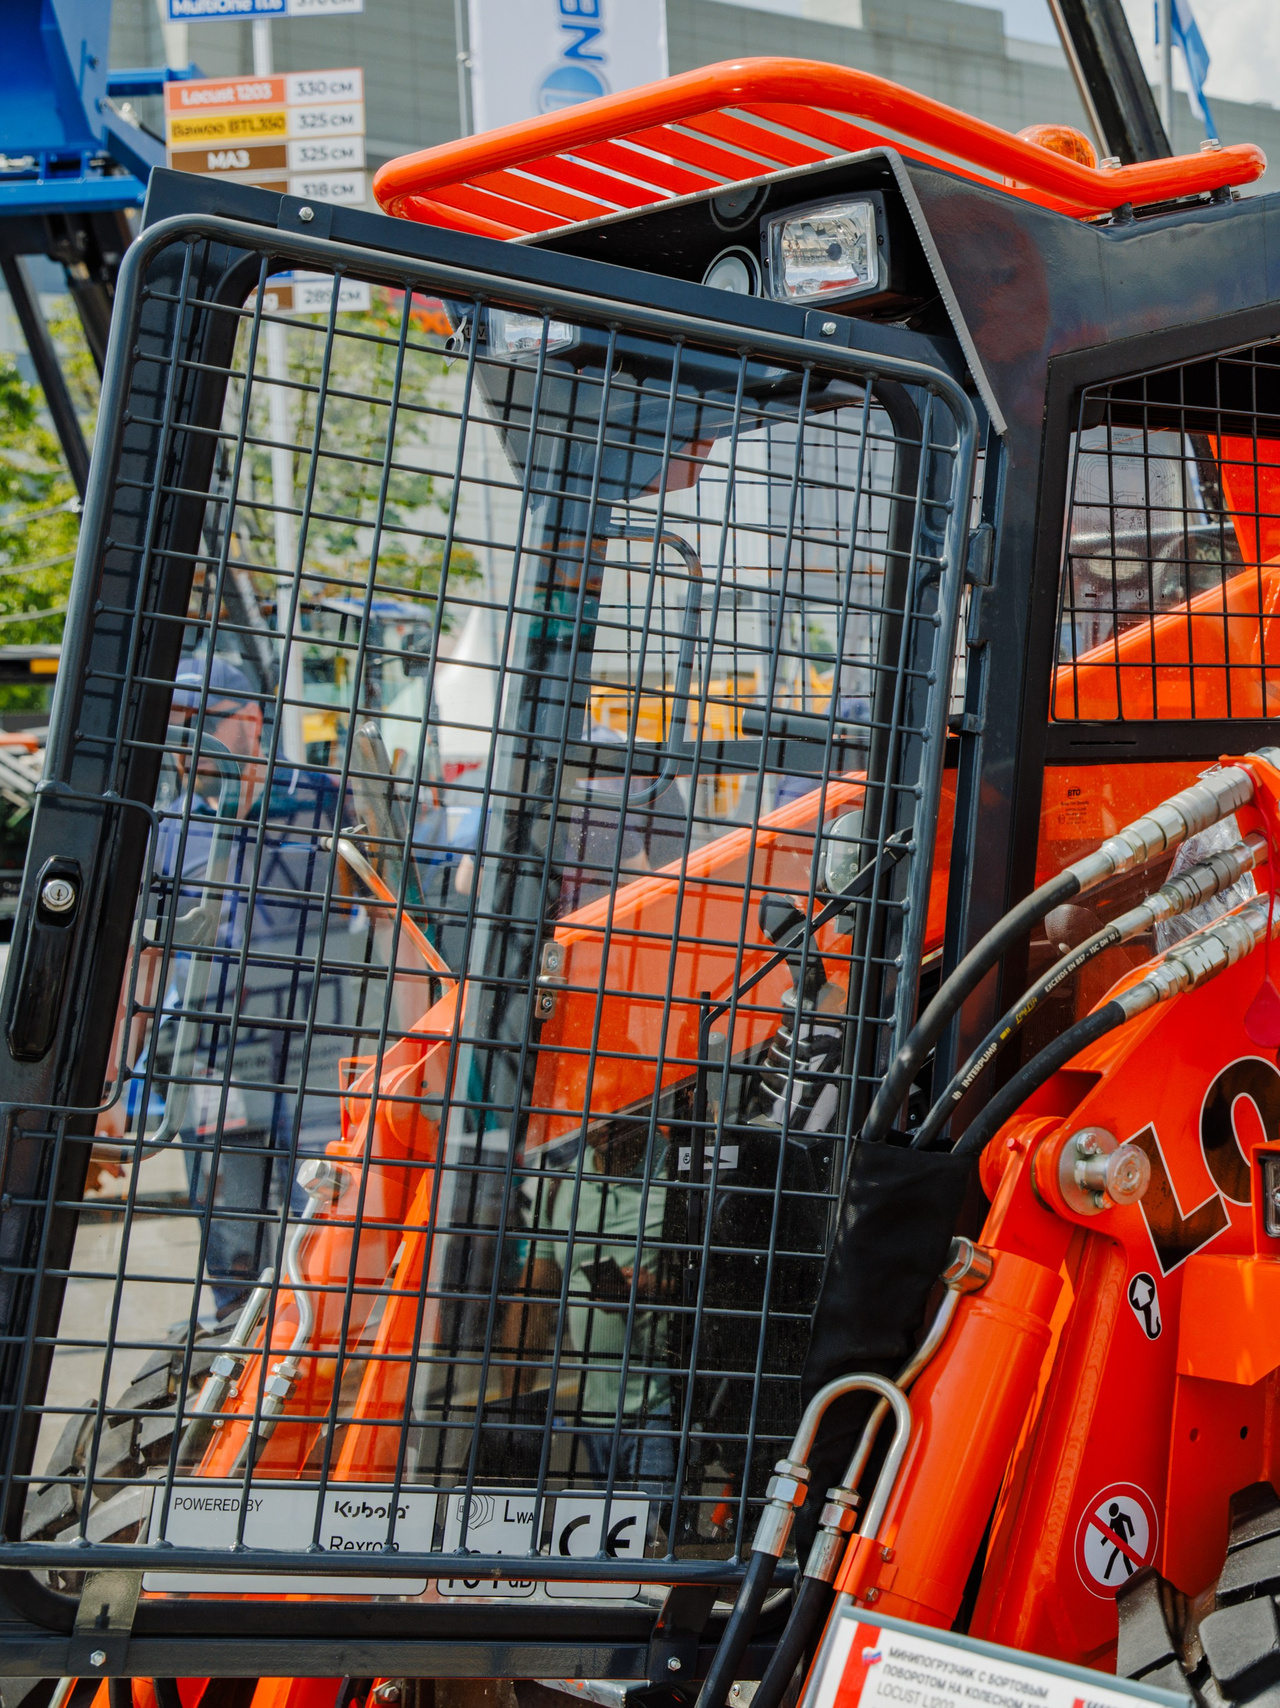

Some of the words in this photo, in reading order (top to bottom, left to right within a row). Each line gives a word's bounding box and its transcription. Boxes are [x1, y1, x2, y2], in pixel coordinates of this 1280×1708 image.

[181, 86, 236, 106] Locust
[236, 83, 273, 102] 1203
[296, 81, 327, 96] 330
[299, 114, 328, 129] 325
[300, 148, 328, 162] 325
[1044, 969, 1069, 993] EXCEEDS
[961, 1042, 998, 1088] INTERPUMP
[174, 1497, 240, 1512] POWERED
[245, 1498, 263, 1512] BY
[876, 1681, 921, 1704] LOCUST
